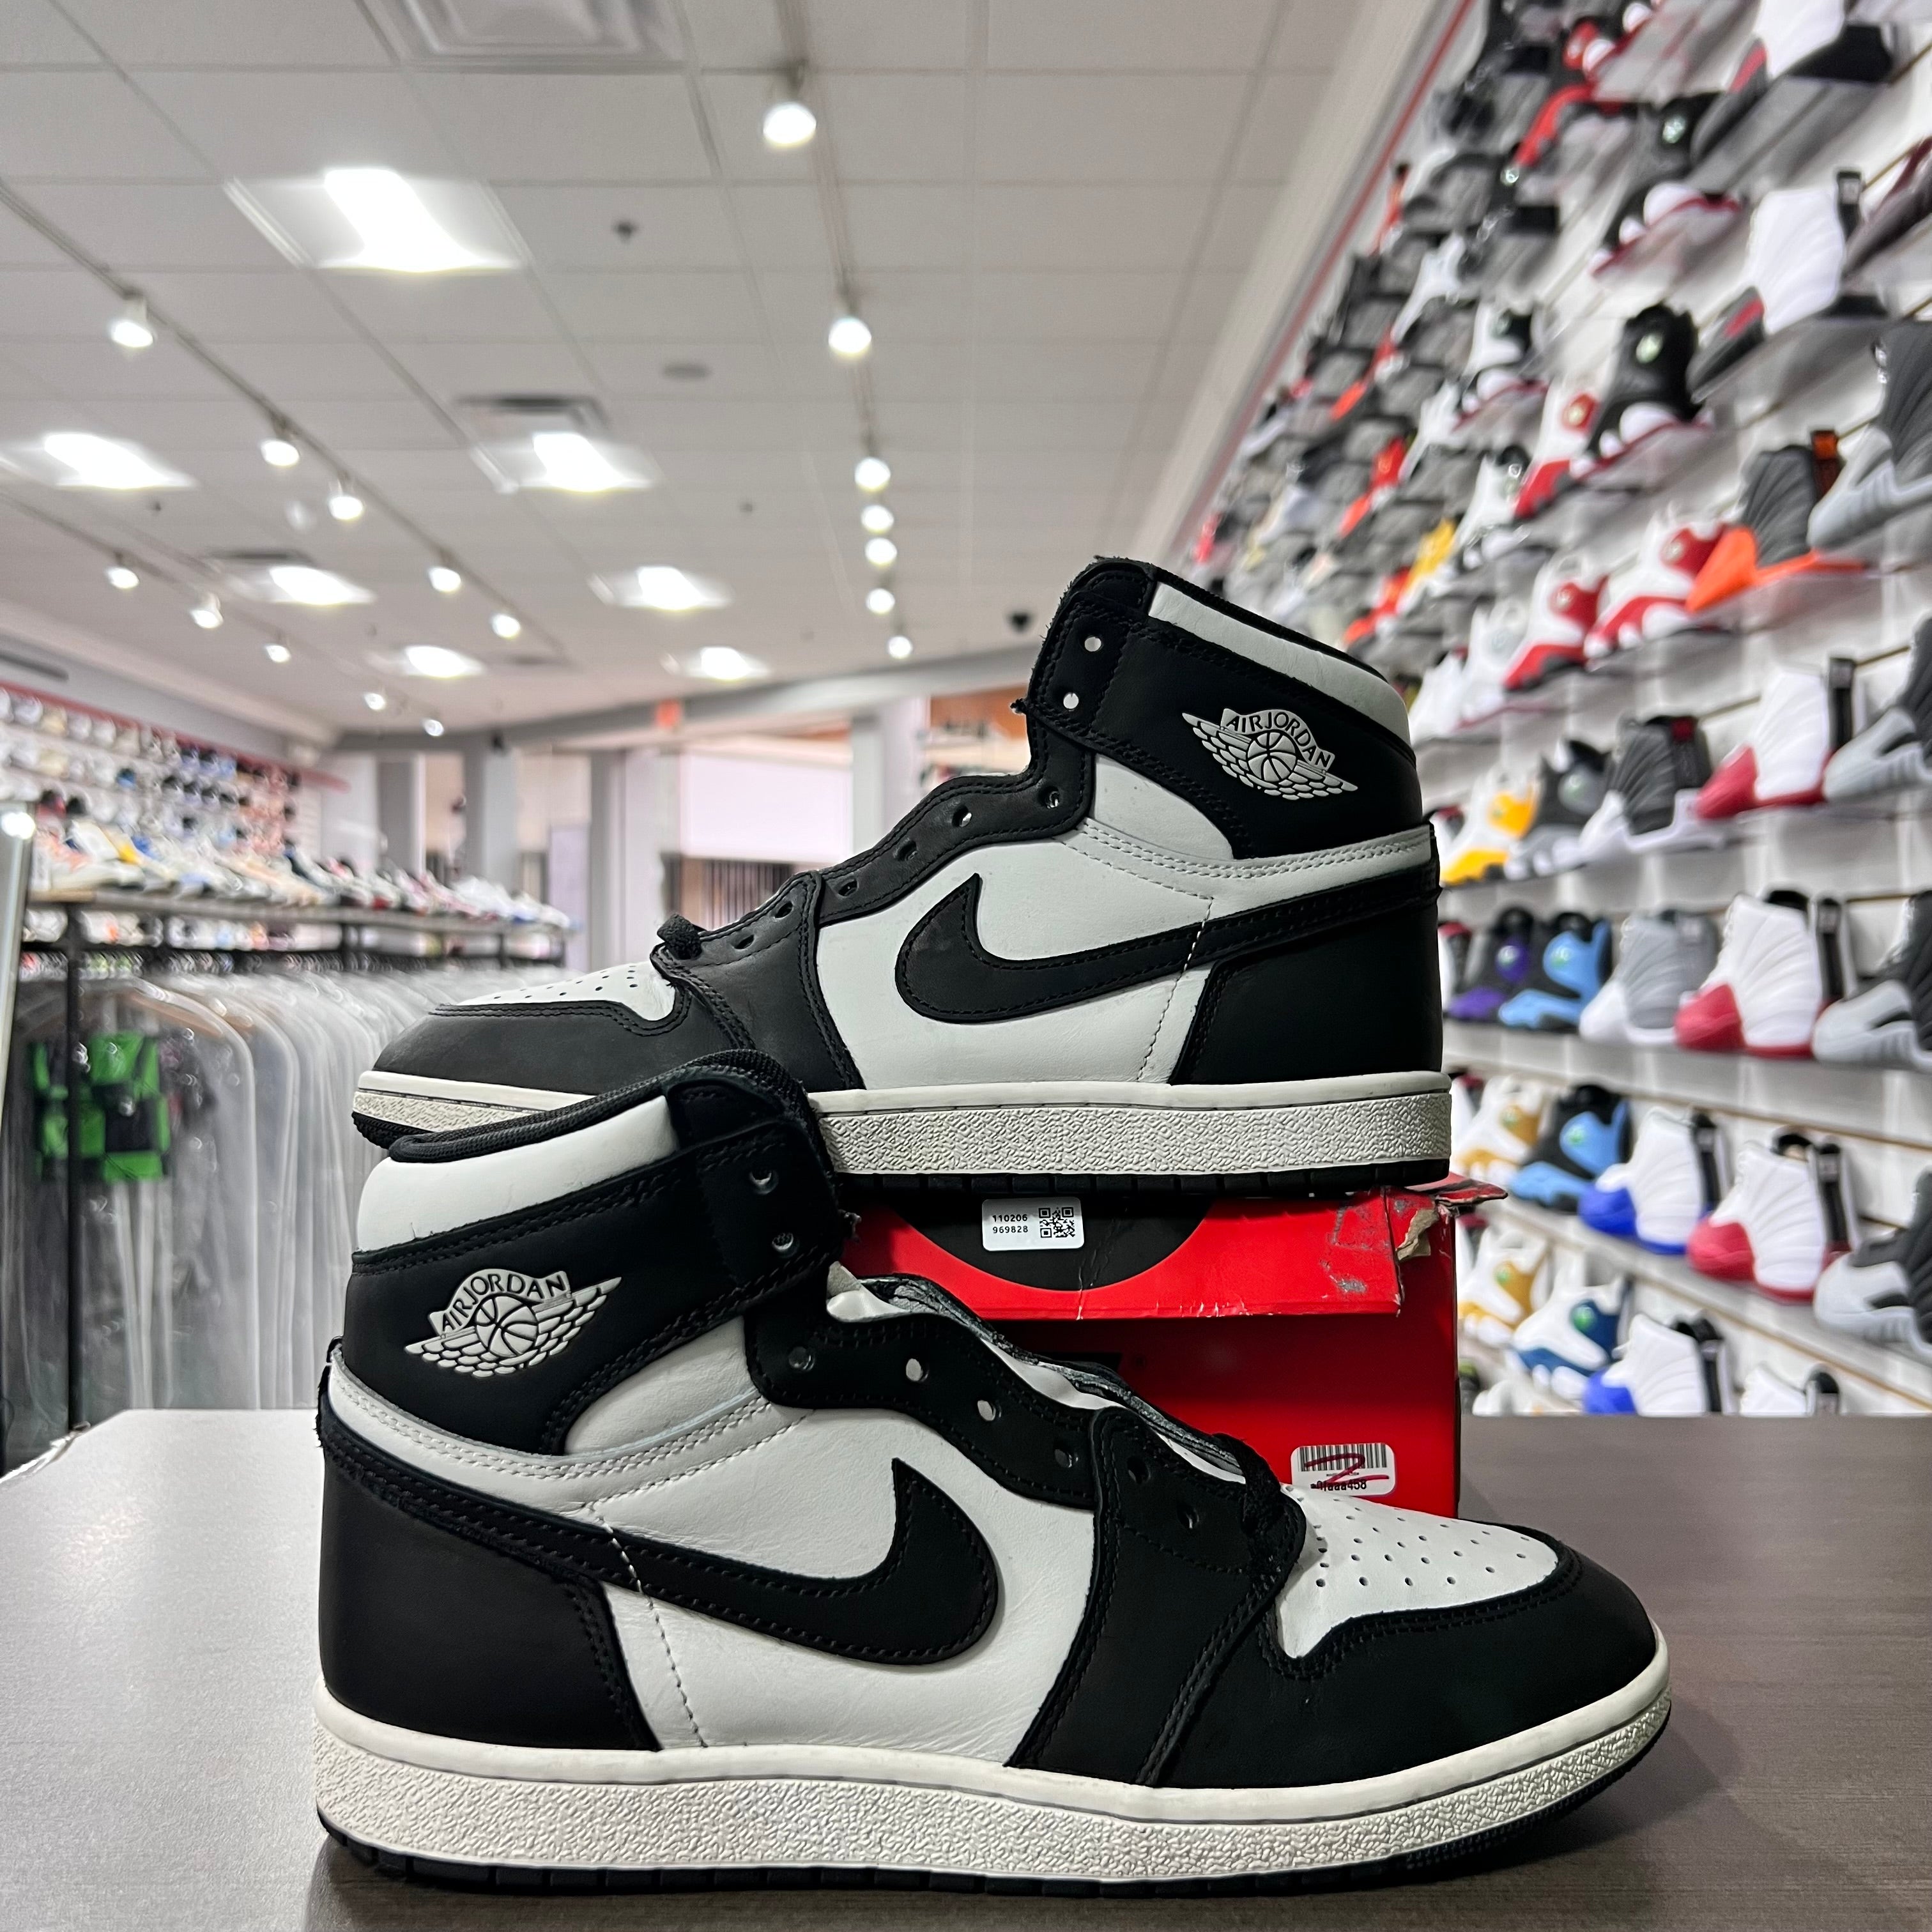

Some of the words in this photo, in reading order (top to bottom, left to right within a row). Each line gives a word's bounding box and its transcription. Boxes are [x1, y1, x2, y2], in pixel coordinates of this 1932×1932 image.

[1226, 714, 1264, 733] AIR
[1265, 712, 1331, 767] JORDAN
[992, 1214, 1028, 1222] 110206
[992, 1225, 1029, 1234] 969828
[442, 1298, 473, 1331] AIR
[463, 1273, 566, 1305] JORDAN
